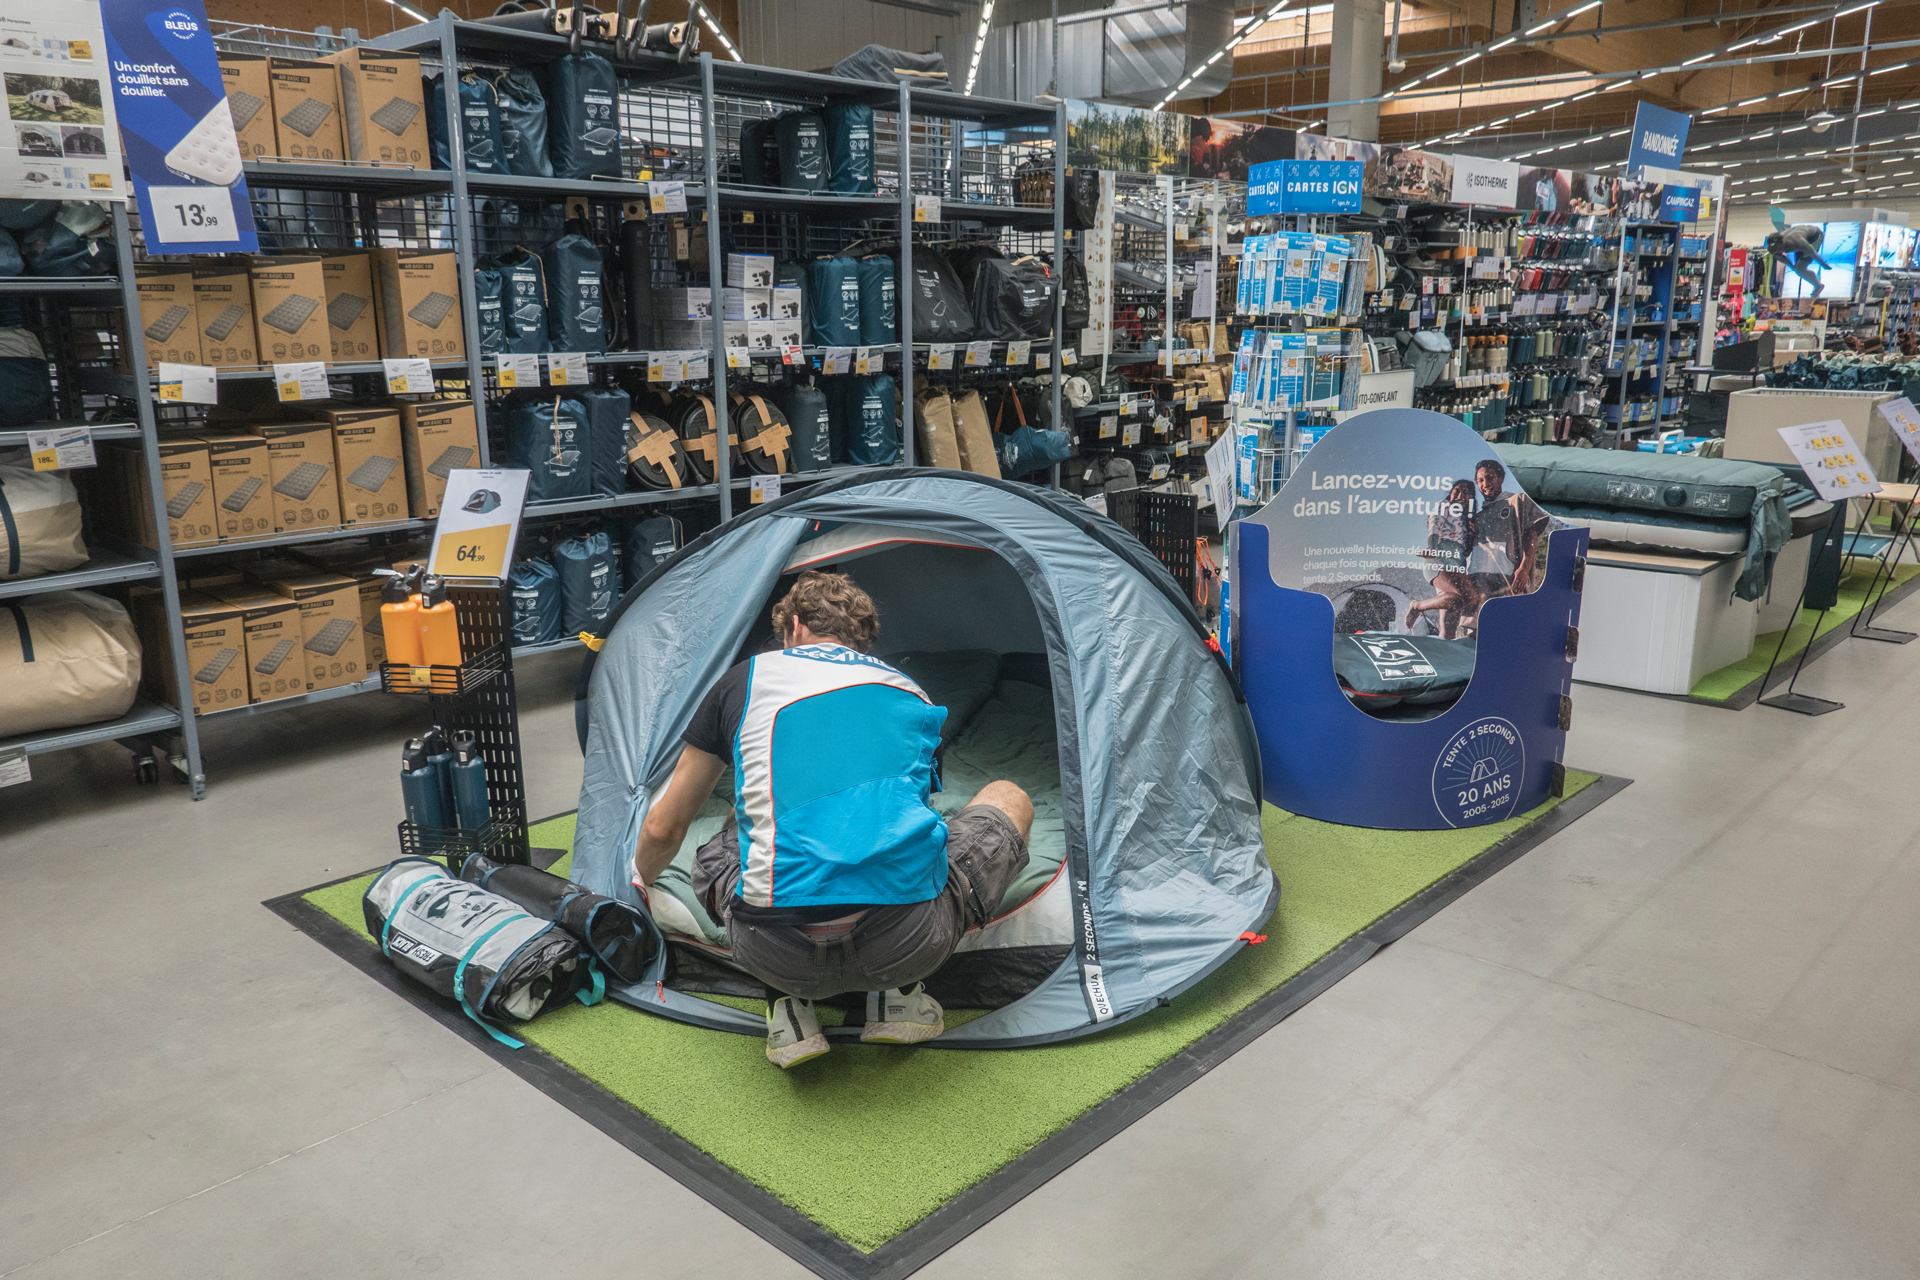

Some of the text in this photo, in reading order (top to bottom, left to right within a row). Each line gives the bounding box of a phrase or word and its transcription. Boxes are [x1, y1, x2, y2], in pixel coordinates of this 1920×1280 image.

[164, 20, 198, 31] BLEUS
[114, 61, 176, 74] Un confort
[118, 74, 189, 86] douillet sans
[120, 86, 166, 97] douiller.
[1642, 131, 1679, 157] RANDONNÉE
[1248, 181, 1280, 196] CARTES IGN
[1287, 180, 1358, 194] CARTES IGN
[1474, 176, 1508, 189] ISOTHERME
[1666, 195, 1695, 207] CAMPINGAZ
[1311, 470, 1454, 491] Lancez-vous
[1293, 494, 1474, 518] dans l'aventure !
[1304, 544, 1460, 559] Une nouvelle histoire démarre à
[1303, 558, 1466, 574] chaque fois que vous ouvrez une
[1303, 571, 1384, 584] tente 2 Seconds.
[1443, 724, 1516, 768] TENTE 2 SECONDS
[1458, 774, 1511, 806] 20 ANS
[1091, 974, 1109, 1014] QUECHUA
